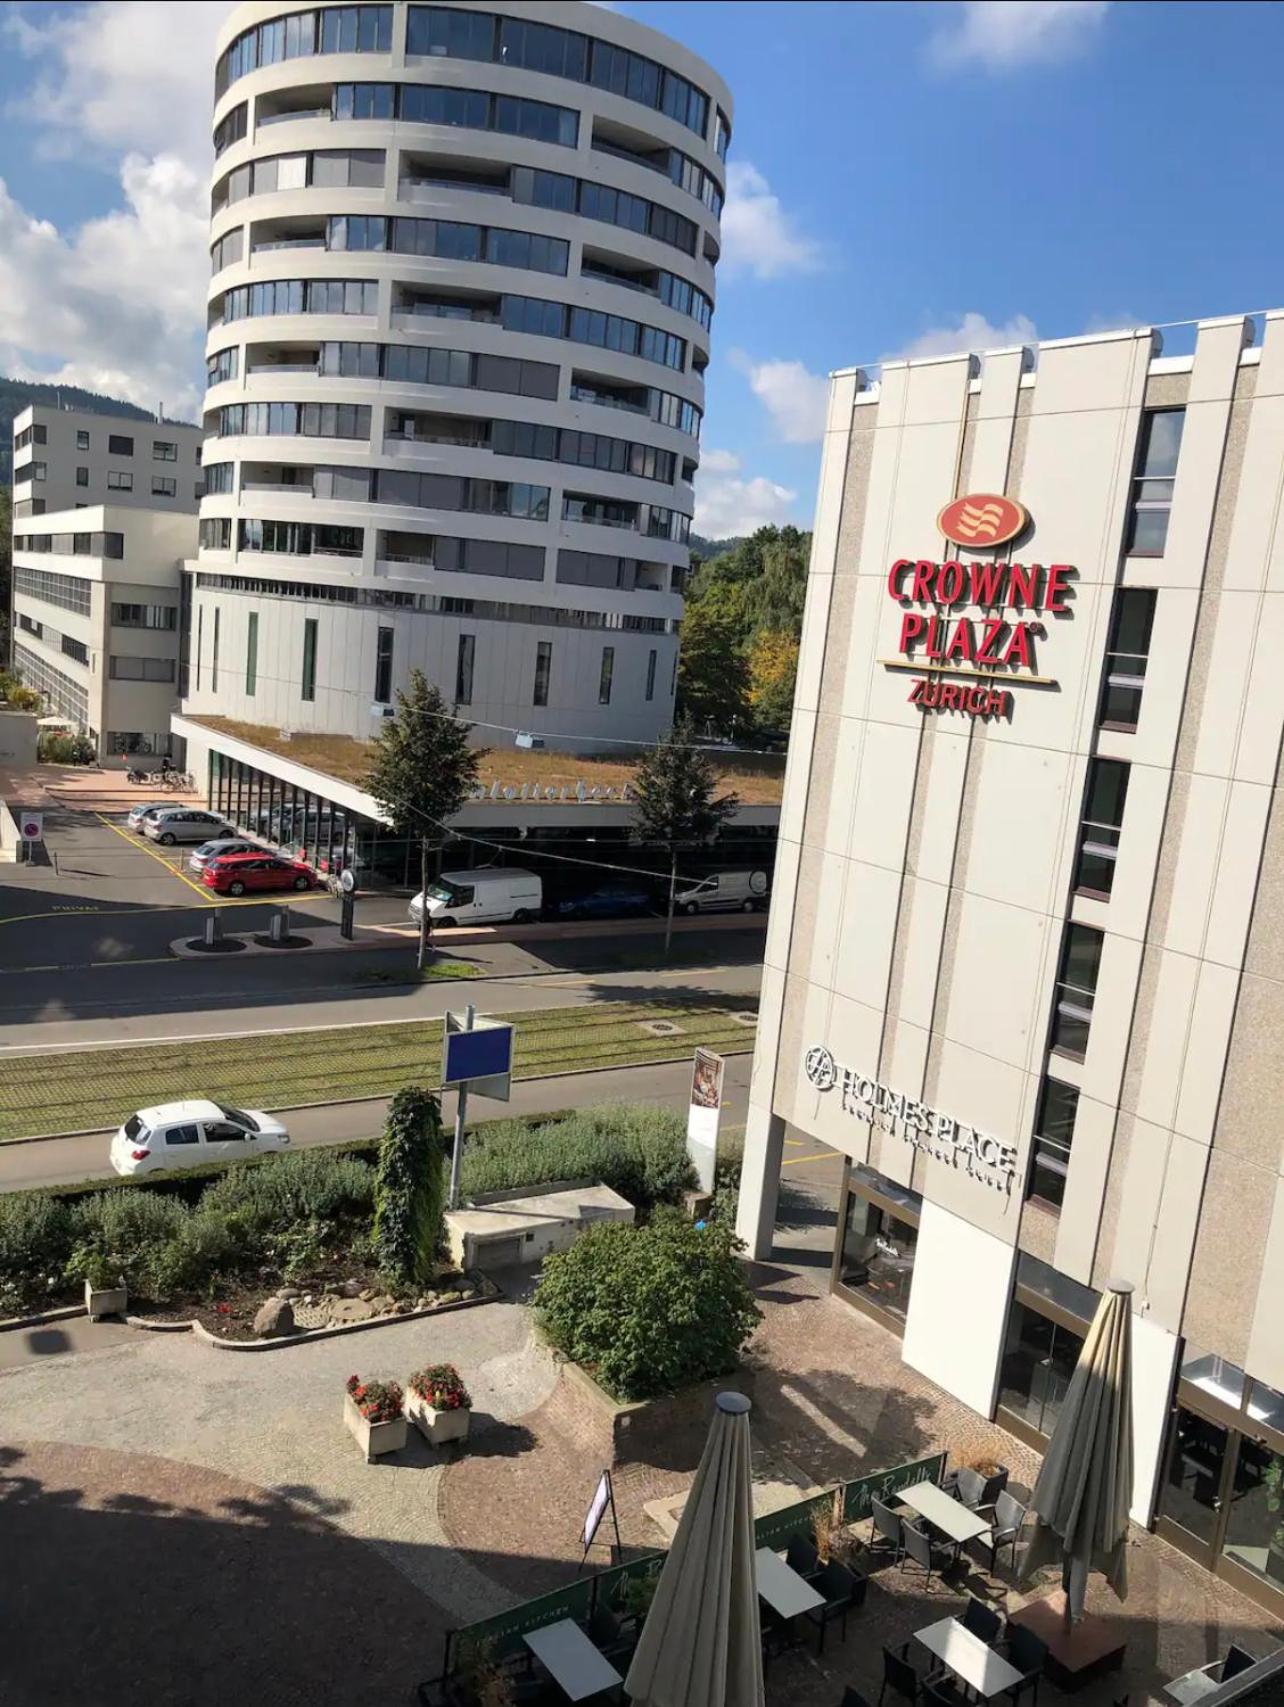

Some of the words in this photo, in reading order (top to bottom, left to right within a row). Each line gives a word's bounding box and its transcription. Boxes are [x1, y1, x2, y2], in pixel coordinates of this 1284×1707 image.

[888, 559, 1072, 612] CROWNE
[839, 1067, 931, 1132] HOLMES
[931, 1112, 1018, 1171] PLACE
